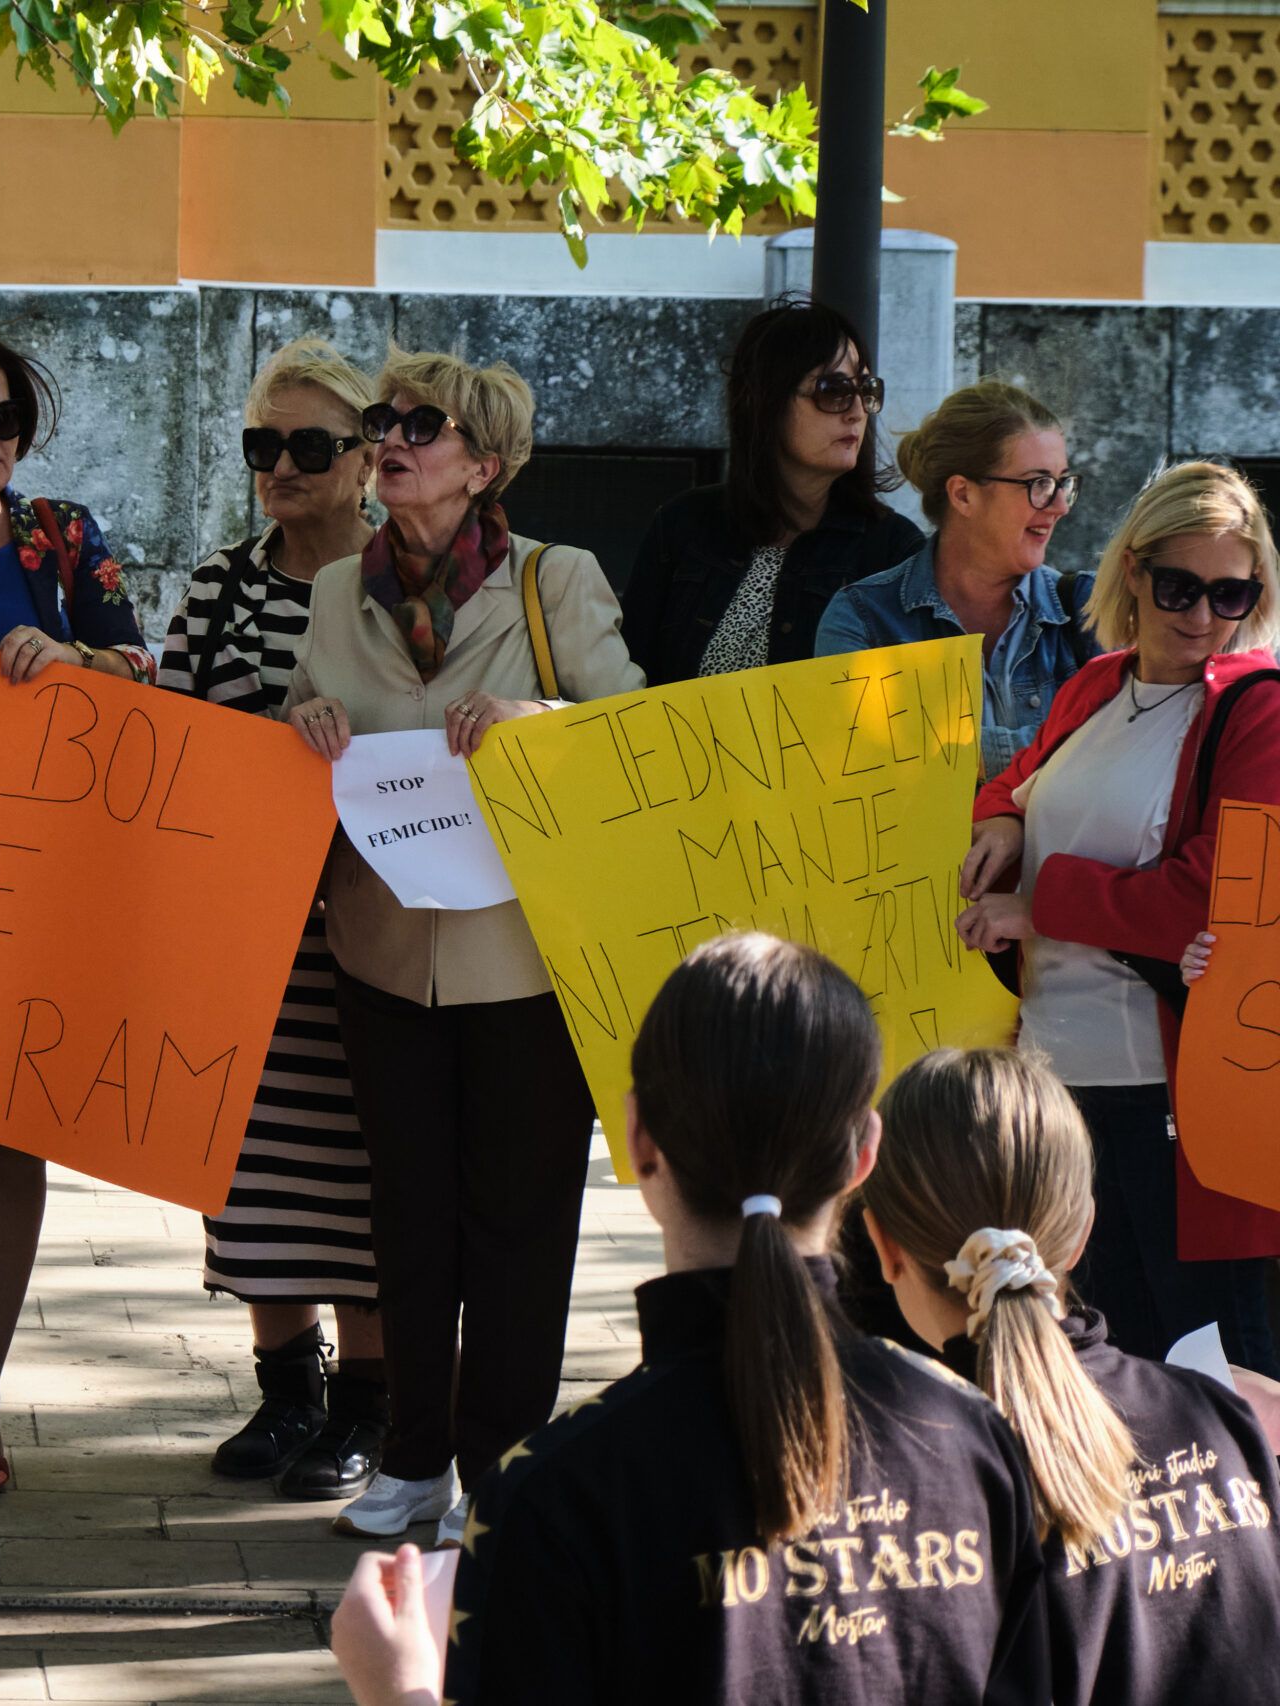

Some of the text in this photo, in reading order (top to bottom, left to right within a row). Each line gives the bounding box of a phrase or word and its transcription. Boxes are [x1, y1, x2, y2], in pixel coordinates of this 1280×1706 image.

[468, 657, 979, 854] NI JEDNA ŽENA
[376, 776, 425, 795] STOP
[367, 812, 473, 849] FEMICIDU!
[678, 788, 899, 912] MANJE
[546, 941, 635, 1047] NI
[1165, 1441, 1218, 1485] studio
[846, 1487, 911, 1533] studio
[1147, 1551, 1218, 1595] Mostar
[796, 1604, 887, 1646] Mostar
